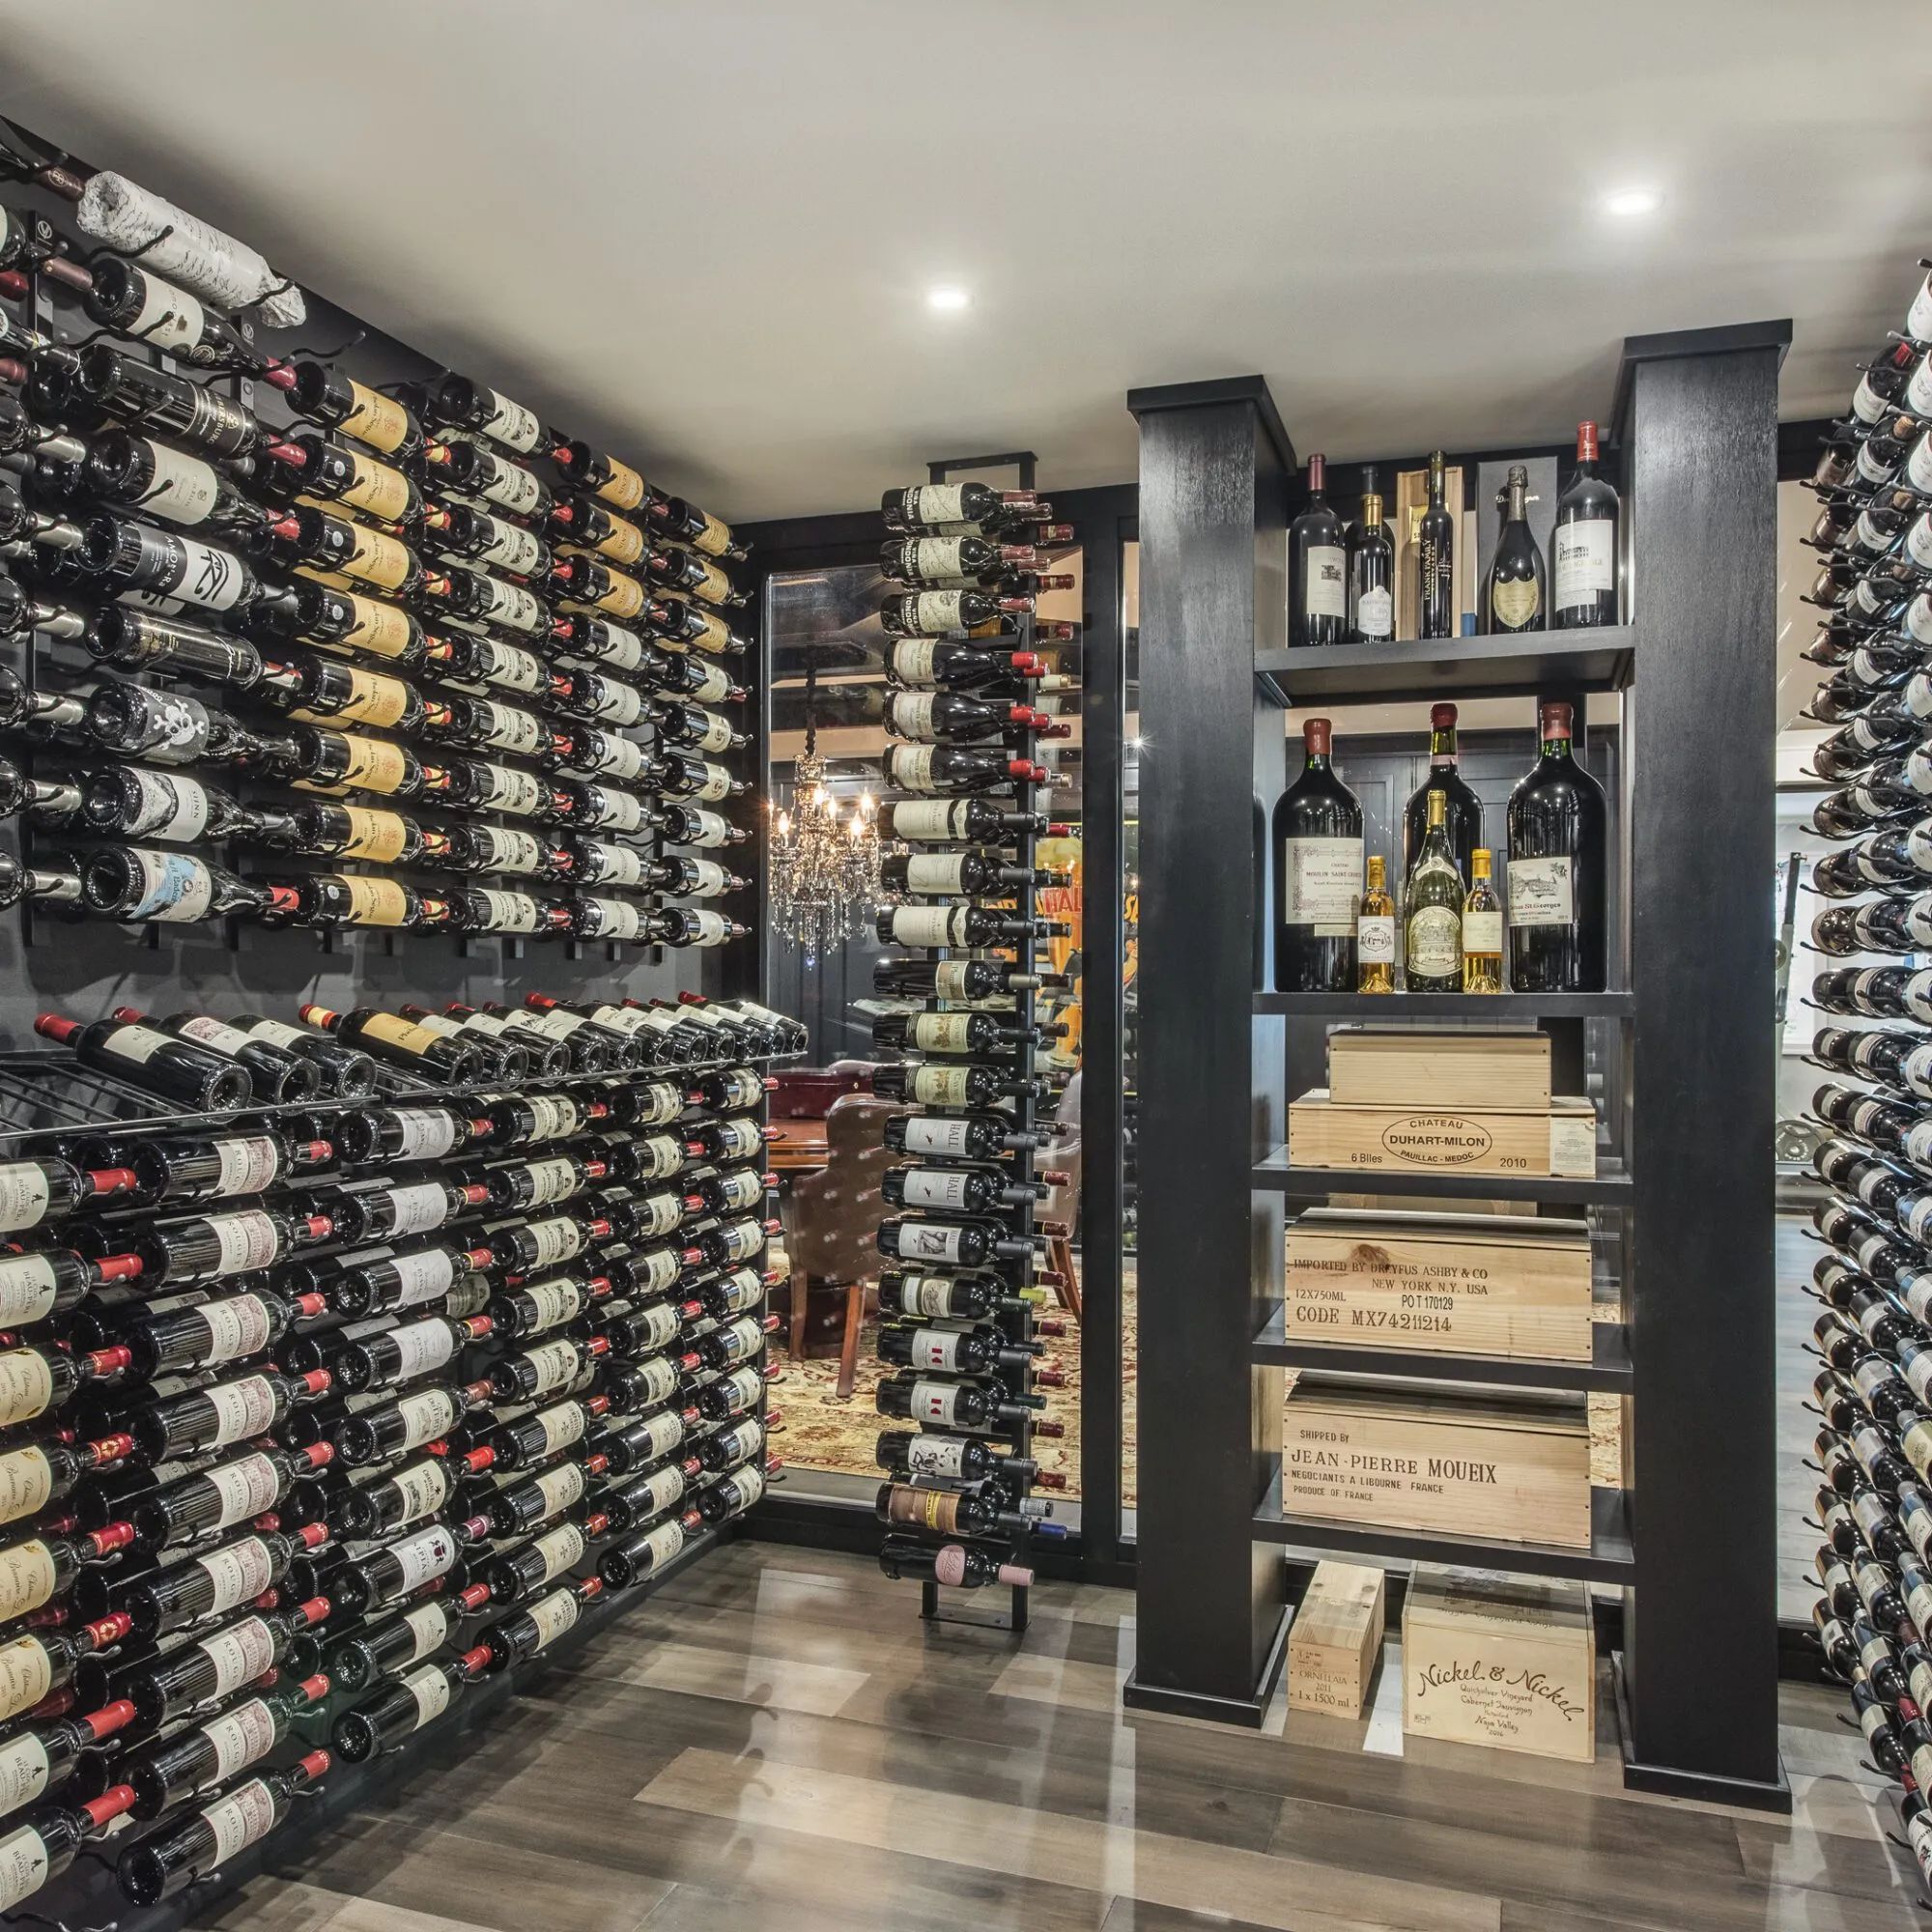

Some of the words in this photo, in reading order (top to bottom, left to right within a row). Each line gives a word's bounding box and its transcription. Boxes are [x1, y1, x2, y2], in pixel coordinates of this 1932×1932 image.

[906, 487, 915, 520] NDONIA
[1422, 539, 1432, 570] FAMILY
[1410, 1119, 1463, 1129] CHATEAU
[948, 1123, 962, 1149] HALL
[1389, 1134, 1485, 1147] DUHART-MILON
[1350, 1152, 1358, 1163] 6
[1400, 1150, 1438, 1163] PAUILLAC
[1444, 1151, 1474, 1163] MEDOC
[1499, 1157, 1527, 1169] 2010
[947, 1176, 960, 1200] HALL
[1293, 1259, 1347, 1271] IMPORTED
[1352, 1262, 1366, 1272] BY
[1370, 1264, 1418, 1276] DREYFUS
[1422, 1265, 1458, 1277] ASHBY
[1461, 1268, 1470, 1279] &
[1472, 1268, 1488, 1280] CO
[1295, 1289, 1347, 1302] 12X750ML
[1372, 1278, 1395, 1290] NEW
[1401, 1280, 1432, 1292] YORK
[1437, 1280, 1461, 1293] N.Y.
[1466, 1283, 1488, 1295] USA
[1425, 1296, 1453, 1310] 170129
[1296, 1305, 1340, 1324] CODE
[1351, 1309, 1452, 1332] MX74211214
[1299, 1430, 1337, 1441] SHIPPED
[1340, 1434, 1350, 1443] BY
[1428, 1458, 1497, 1484] MOUEIX
[1291, 1469, 1345, 1484] NEGOCIANTS
[1350, 1475, 1356, 1485] A
[1360, 1476, 1402, 1490] LIBOURNE
[1410, 1482, 1444, 1493] FRANCE
[1293, 1485, 1325, 1496] PRODUCE
[1330, 1489, 1340, 1497] OF
[1345, 1491, 1374, 1501] FRANCE
[1298, 1690, 1302, 1699] 1
[1314, 1692, 1336, 1705] 1500
[1337, 1697, 1350, 1708] ml
[1417, 1661, 1486, 1697] Nickel
[1489, 1666, 1505, 1682] &
[1506, 1669, 1585, 1721] Nickel
[1501, 1689, 1533, 1703] Vineyard
[1461, 1695, 1494, 1708] Cabernet
[1495, 1700, 1533, 1717] Sauvignon
[1475, 1715, 1495, 1730] Napa
[1497, 1719, 1519, 1734] Valley
